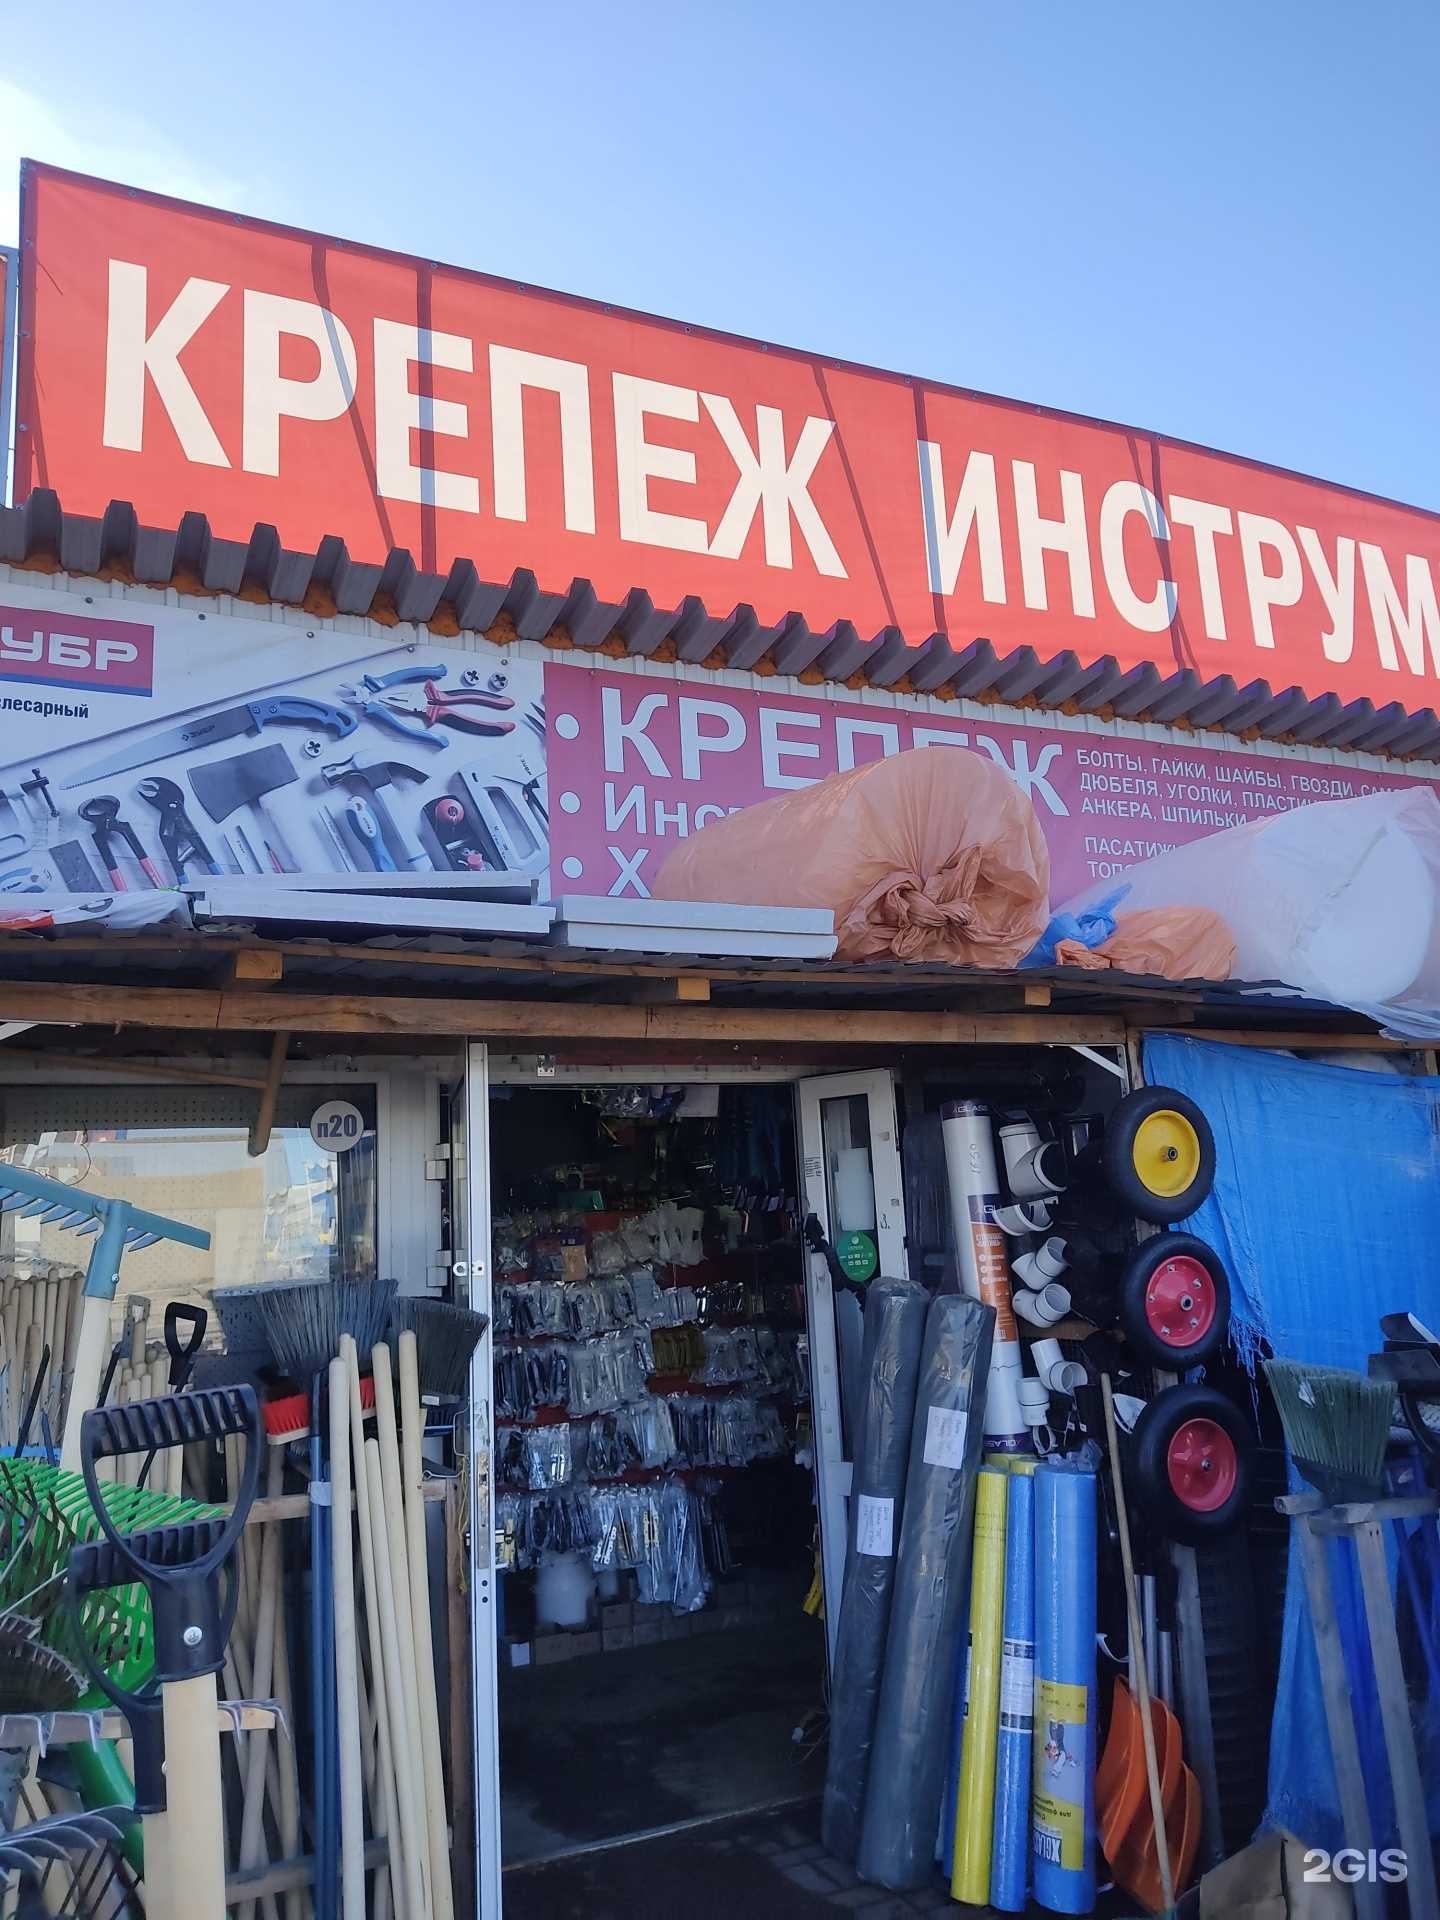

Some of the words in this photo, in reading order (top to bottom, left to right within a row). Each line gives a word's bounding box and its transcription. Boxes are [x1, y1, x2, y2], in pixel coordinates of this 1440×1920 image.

[102, 258, 849, 579] КРЕПЕЖ
[917, 439, 1440, 679] ИНСТРУМ
[0, 697, 89, 719] лесарный
[1077, 749, 1147, 773] БОЛТЫ,
[1152, 757, 1211, 783] ГАЙКИ,
[1216, 765, 1287, 791] ШАЙБЫ,
[1080, 772, 1163, 798] ДЮБЕЛЯ,
[1168, 783, 1238, 808] УГОЛКИ,
[1081, 798, 1157, 822] АНКЕРА,
[317, 1114, 357, 1138] п20
